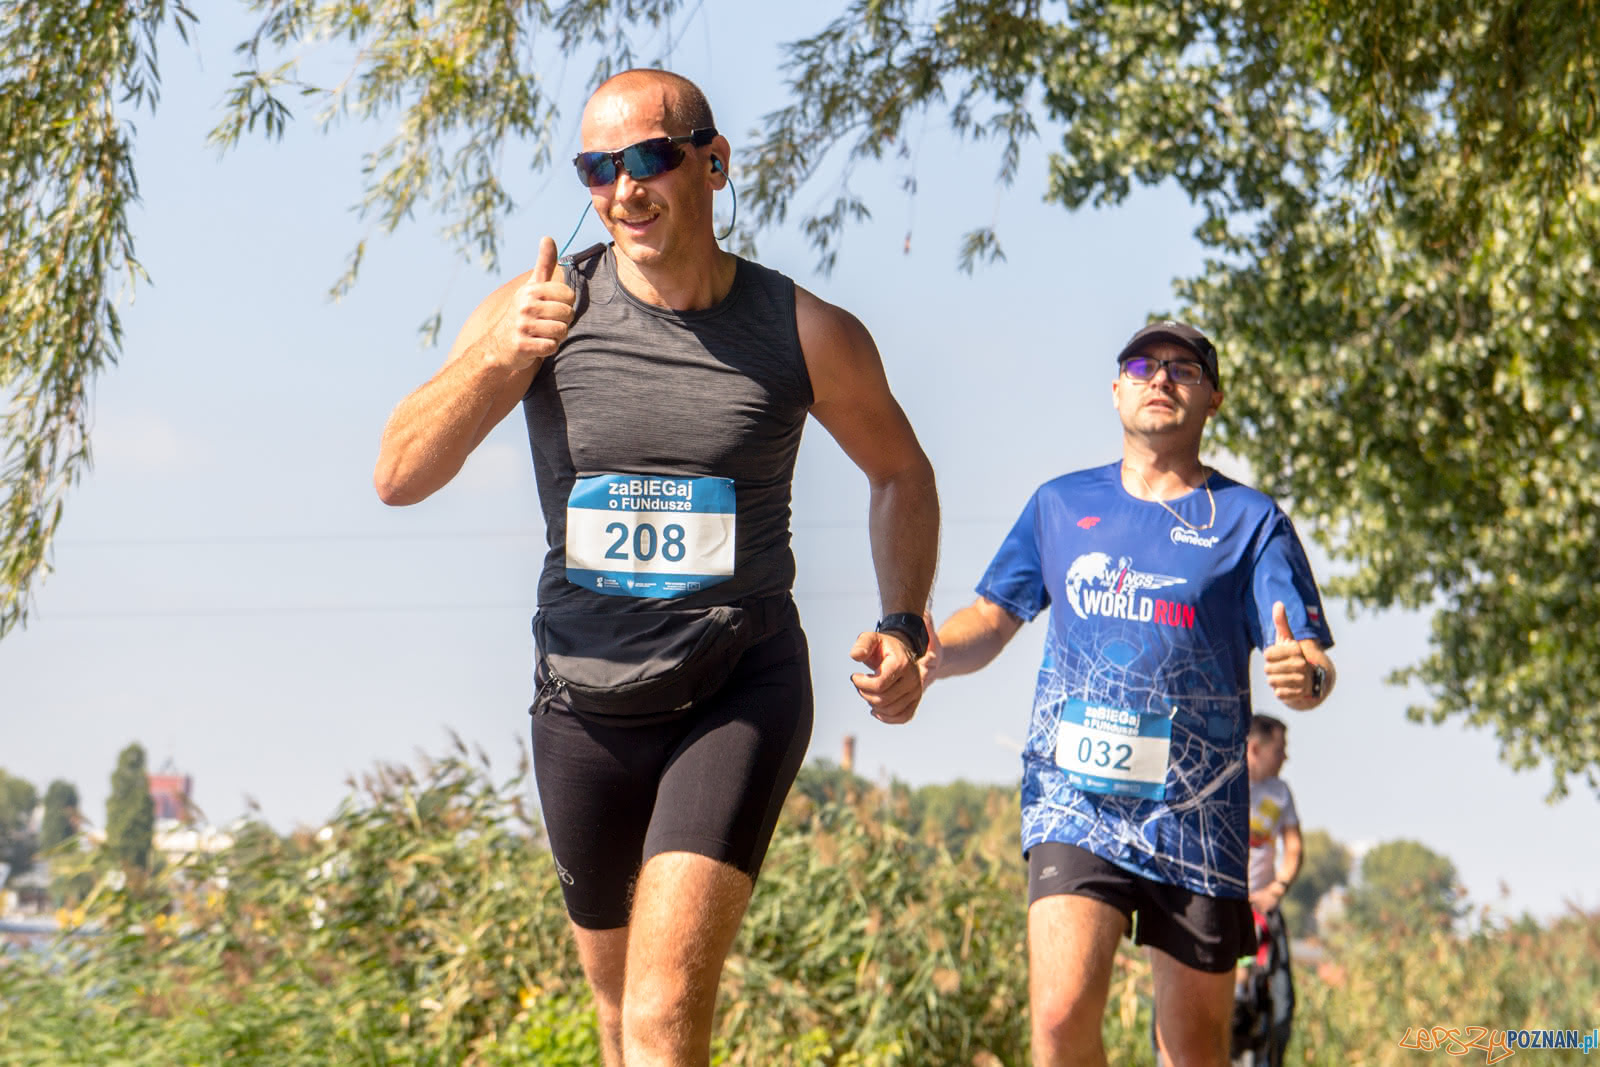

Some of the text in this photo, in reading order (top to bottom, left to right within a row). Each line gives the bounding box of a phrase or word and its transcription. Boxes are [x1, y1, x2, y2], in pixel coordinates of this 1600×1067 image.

[608, 480, 693, 500] zaBIEGaj
[609, 498, 692, 511] o FUNdusze
[604, 522, 686, 562] 208
[1103, 568, 1154, 587] WINGS
[1078, 737, 1133, 771] 032
